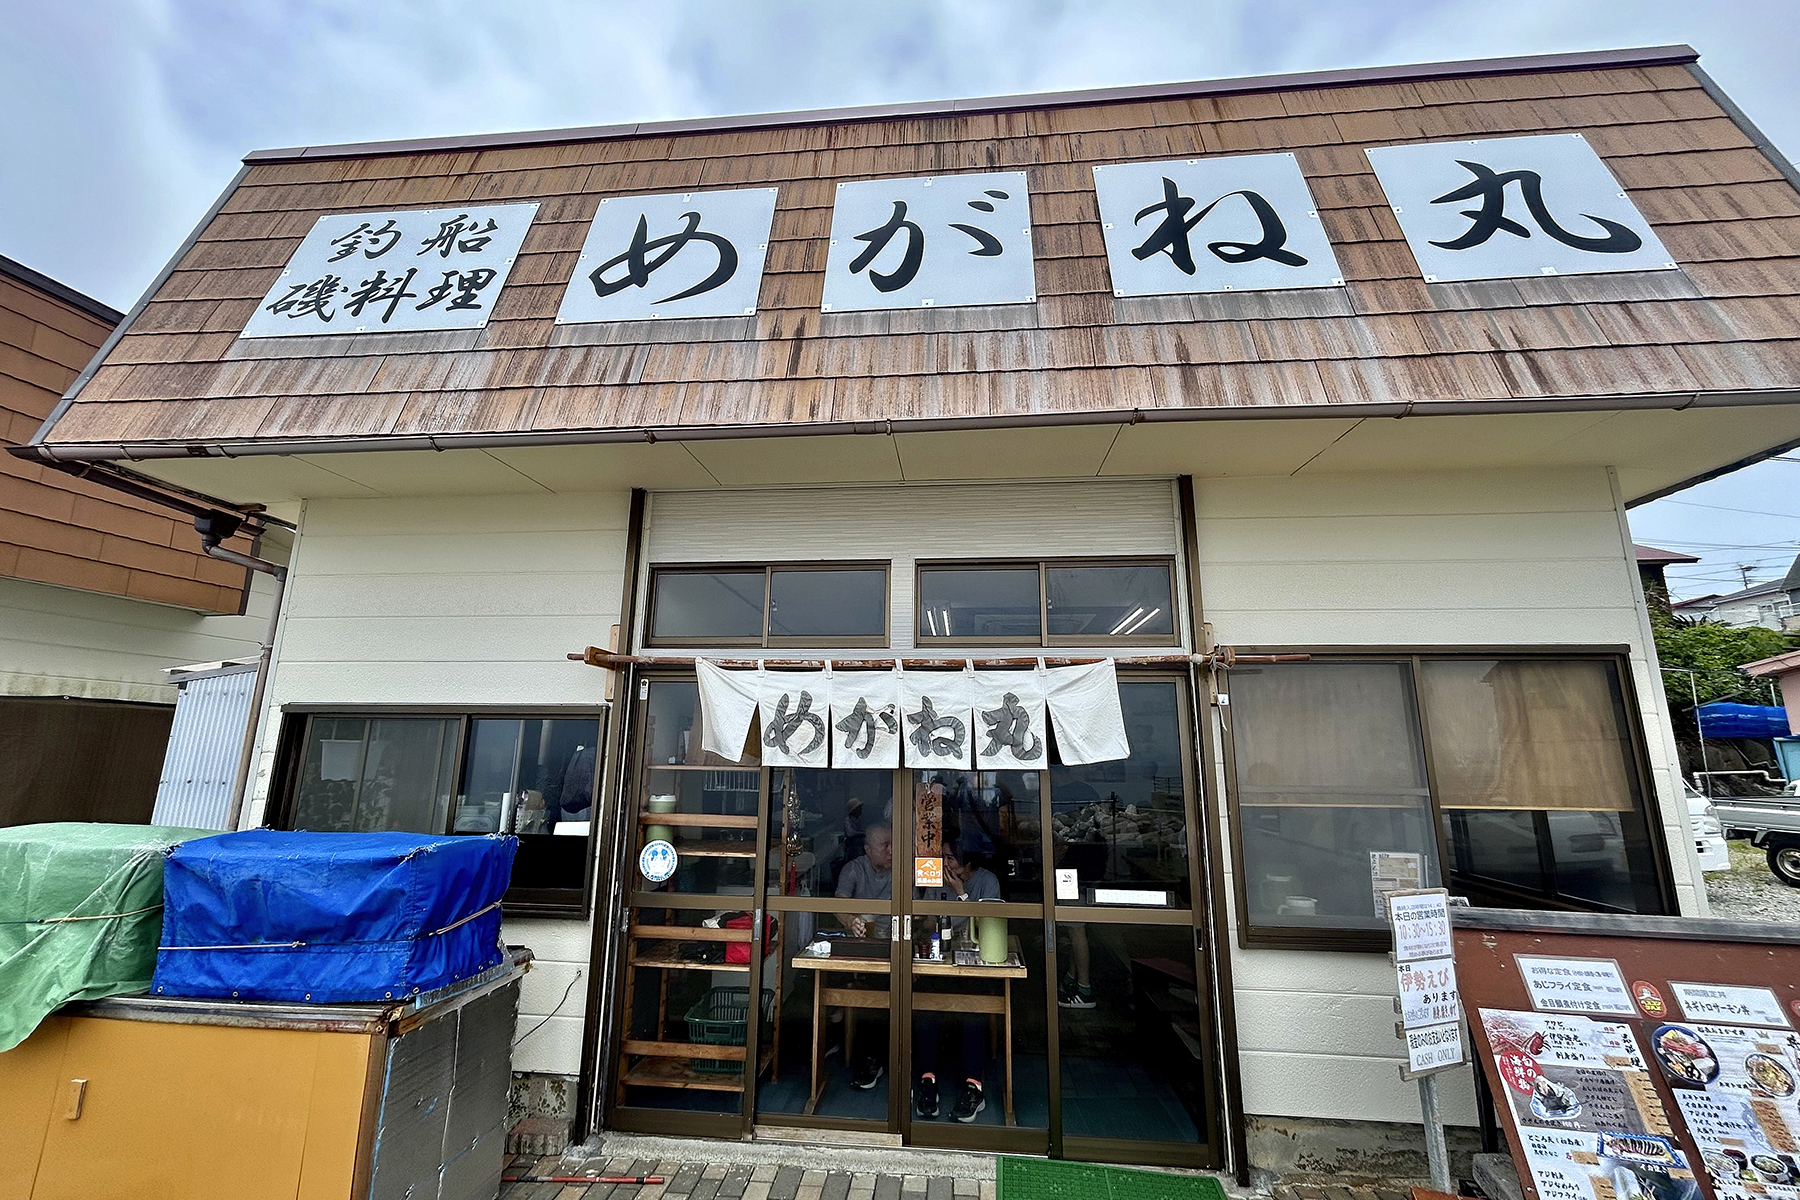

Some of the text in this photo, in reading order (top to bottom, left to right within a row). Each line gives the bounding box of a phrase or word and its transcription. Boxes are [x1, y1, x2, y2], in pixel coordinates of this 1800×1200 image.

[328, 213, 499, 263] 釣船
[588, 158, 1643, 305] めがね丸
[265, 266, 498, 325] 磯料理
[920, 793, 937, 848] 営業中
[917, 869, 941, 878] 食べログ
[1394, 908, 1446, 922] 本日の営業時間
[1398, 964, 1411, 973] 本日
[1401, 967, 1449, 992] 伊勢えび
[1533, 980, 1593, 992] あじフライ定食
[1423, 990, 1457, 1004] あります
[1684, 1000, 1751, 1015] ネギトロサーモン丼
[1416, 1047, 1455, 1066] CASH ONLY
